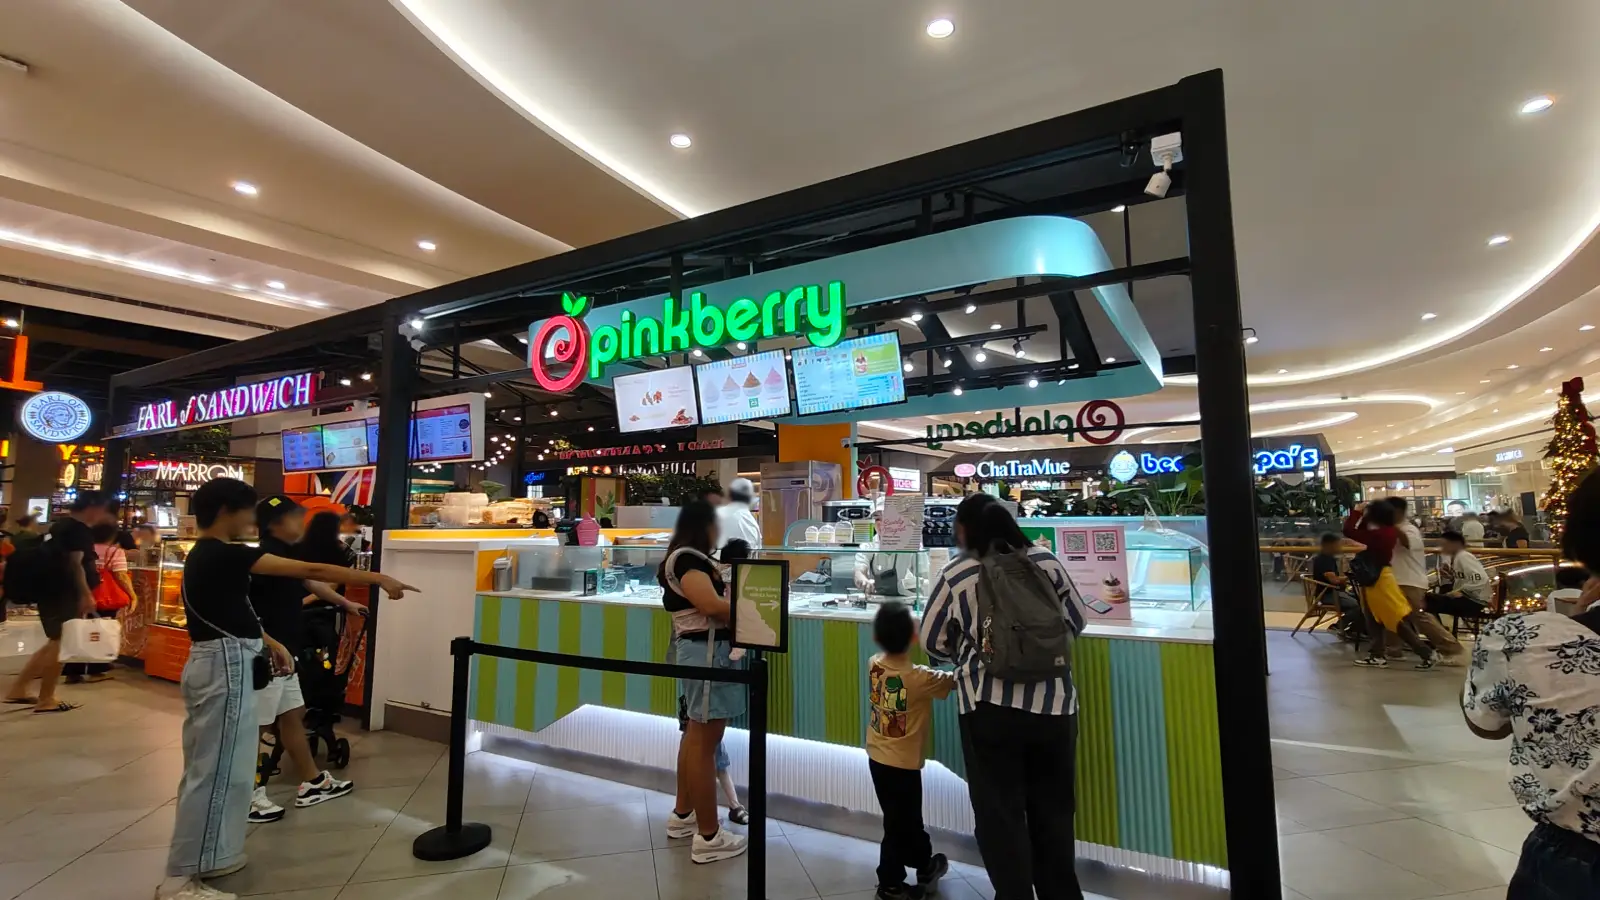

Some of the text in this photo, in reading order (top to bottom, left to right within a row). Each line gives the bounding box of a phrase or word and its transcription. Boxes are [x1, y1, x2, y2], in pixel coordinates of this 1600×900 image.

[588, 281, 845, 379] pinkberry
[31, 394, 83, 410] EARL OF
[136, 373, 313, 432] EARL of SANDWICH
[30, 417, 87, 438] SANDWICH
[976, 458, 1071, 477] ChaTraMue
[1252, 445, 1318, 475] pa's
[155, 461, 243, 482] MARRON
